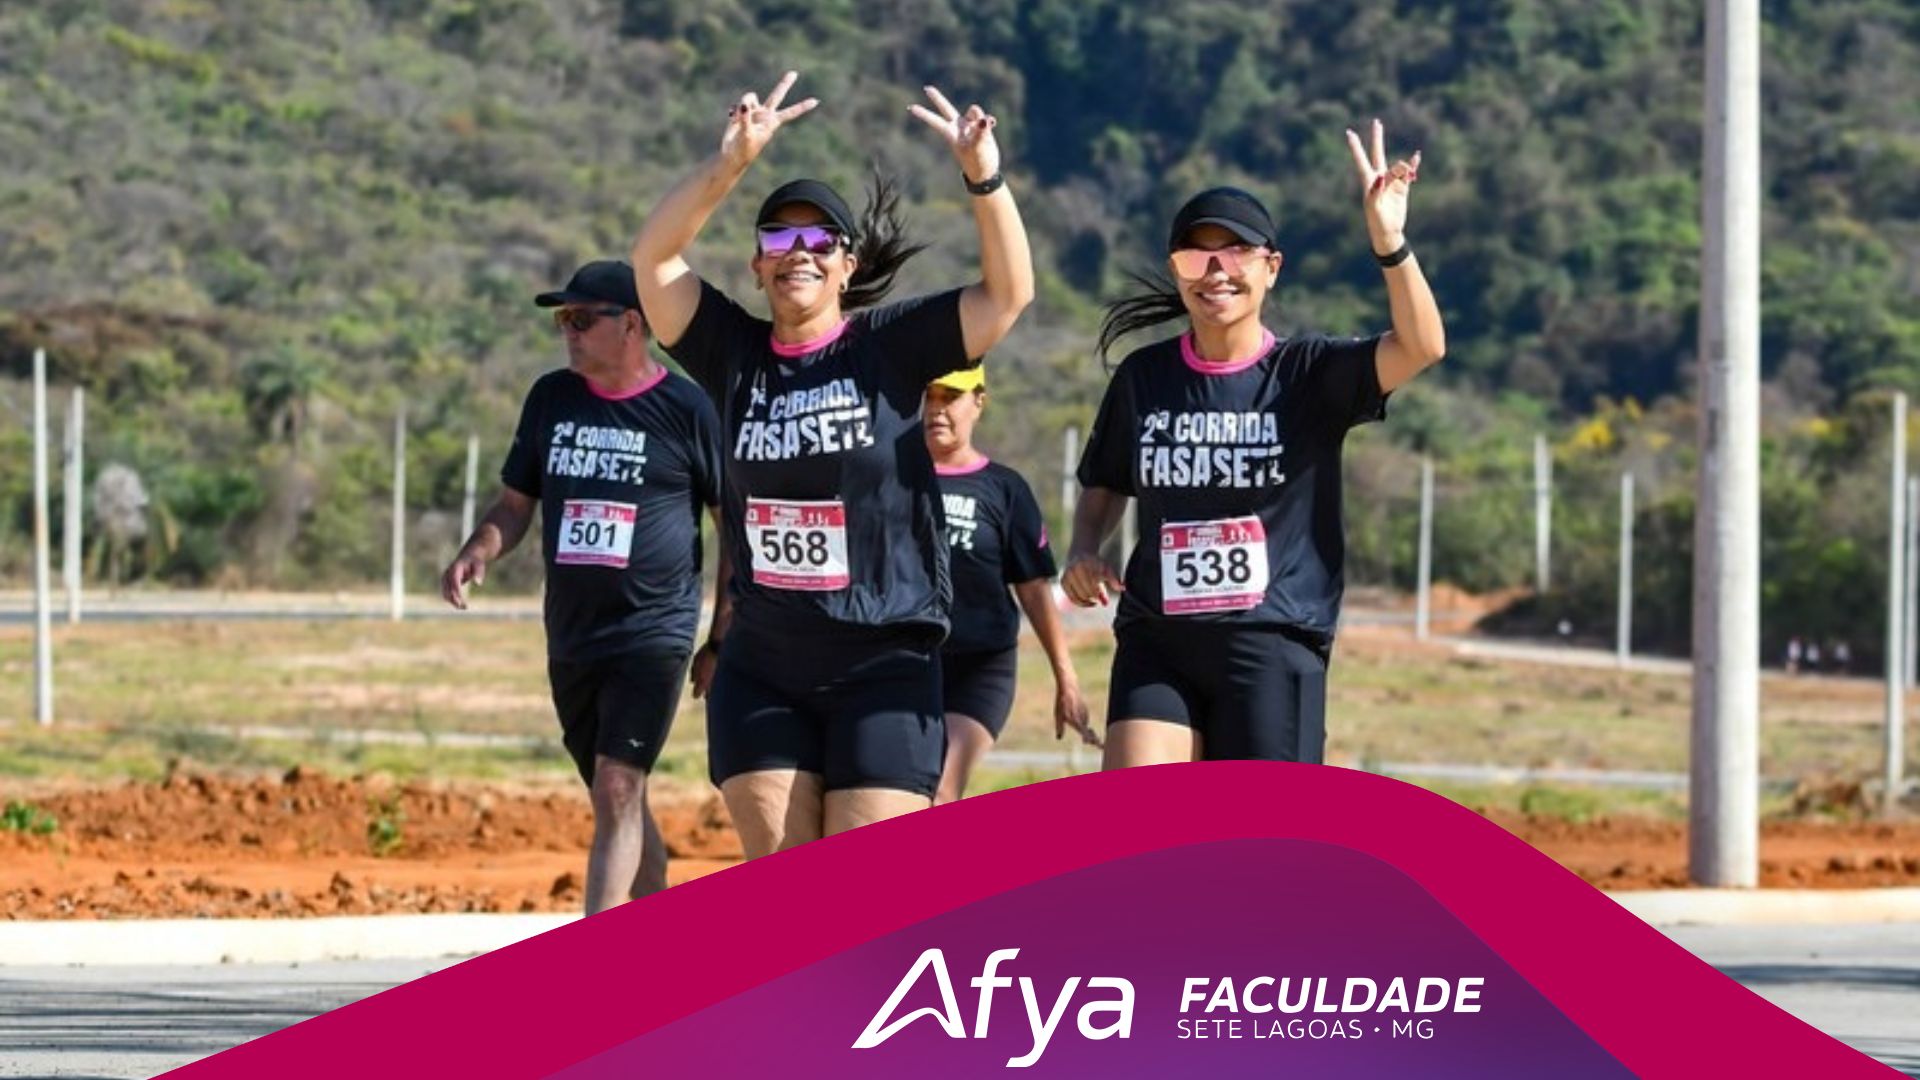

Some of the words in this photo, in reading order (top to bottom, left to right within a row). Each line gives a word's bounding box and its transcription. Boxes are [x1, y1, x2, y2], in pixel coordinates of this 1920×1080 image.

[575, 426, 647, 453] CORRIDA
[1174, 412, 1278, 444] CORRIDA
[568, 520, 617, 547] 501
[761, 530, 829, 567] 568
[1176, 547, 1251, 588] 538
